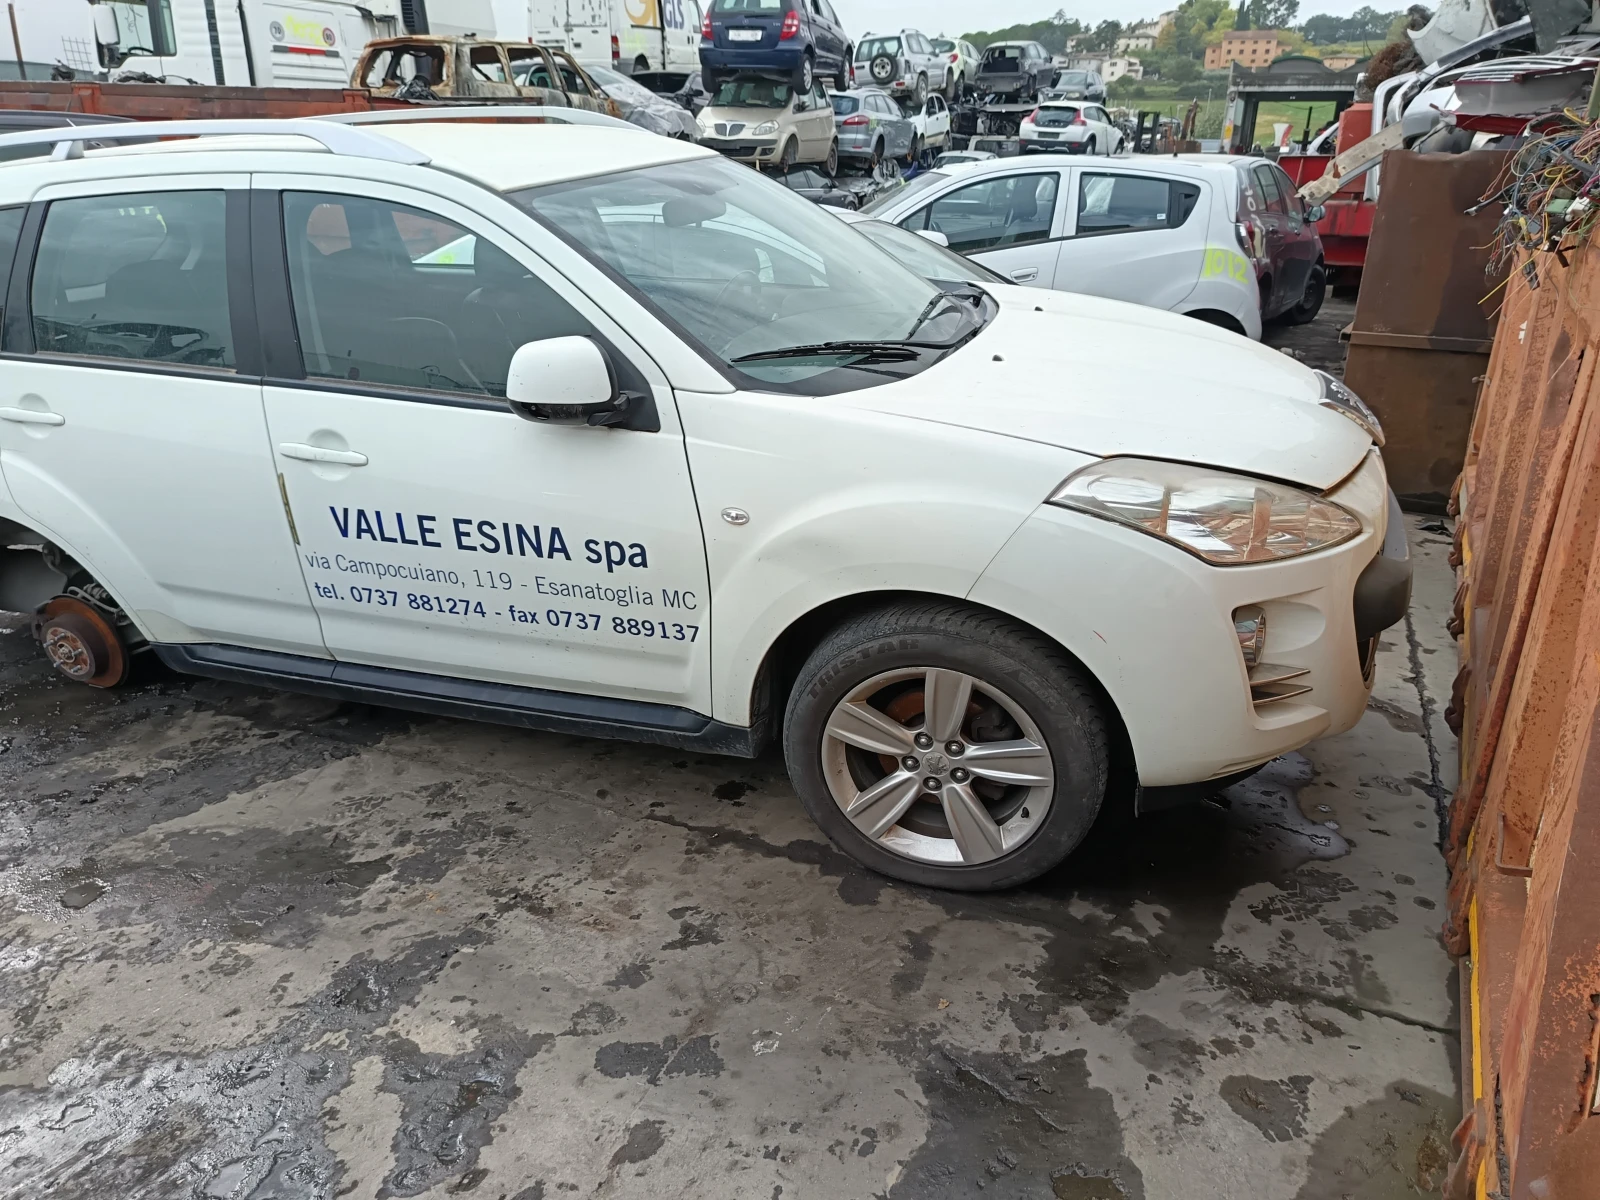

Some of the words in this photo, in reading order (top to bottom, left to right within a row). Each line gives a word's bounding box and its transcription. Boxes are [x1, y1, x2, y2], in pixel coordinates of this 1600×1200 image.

[664, 0, 684, 30] GLS
[1204, 243, 1249, 285] 1012
[329, 506, 441, 548] VALLE
[452, 518, 572, 562] ESINA
[584, 538, 648, 573] spa
[305, 552, 331, 569] via
[335, 554, 465, 588] Campocuiano,
[473, 569, 512, 591] 119
[535, 576, 653, 607] Esanatoglia
[662, 589, 697, 610] MC
[315, 582, 344, 600] tel.
[350, 586, 397, 607] 0737
[407, 593, 486, 618] 881274
[508, 605, 540, 624] fax
[546, 609, 601, 631] 0737
[612, 616, 699, 643] 889137
[807, 639, 920, 700] TRISTAR
